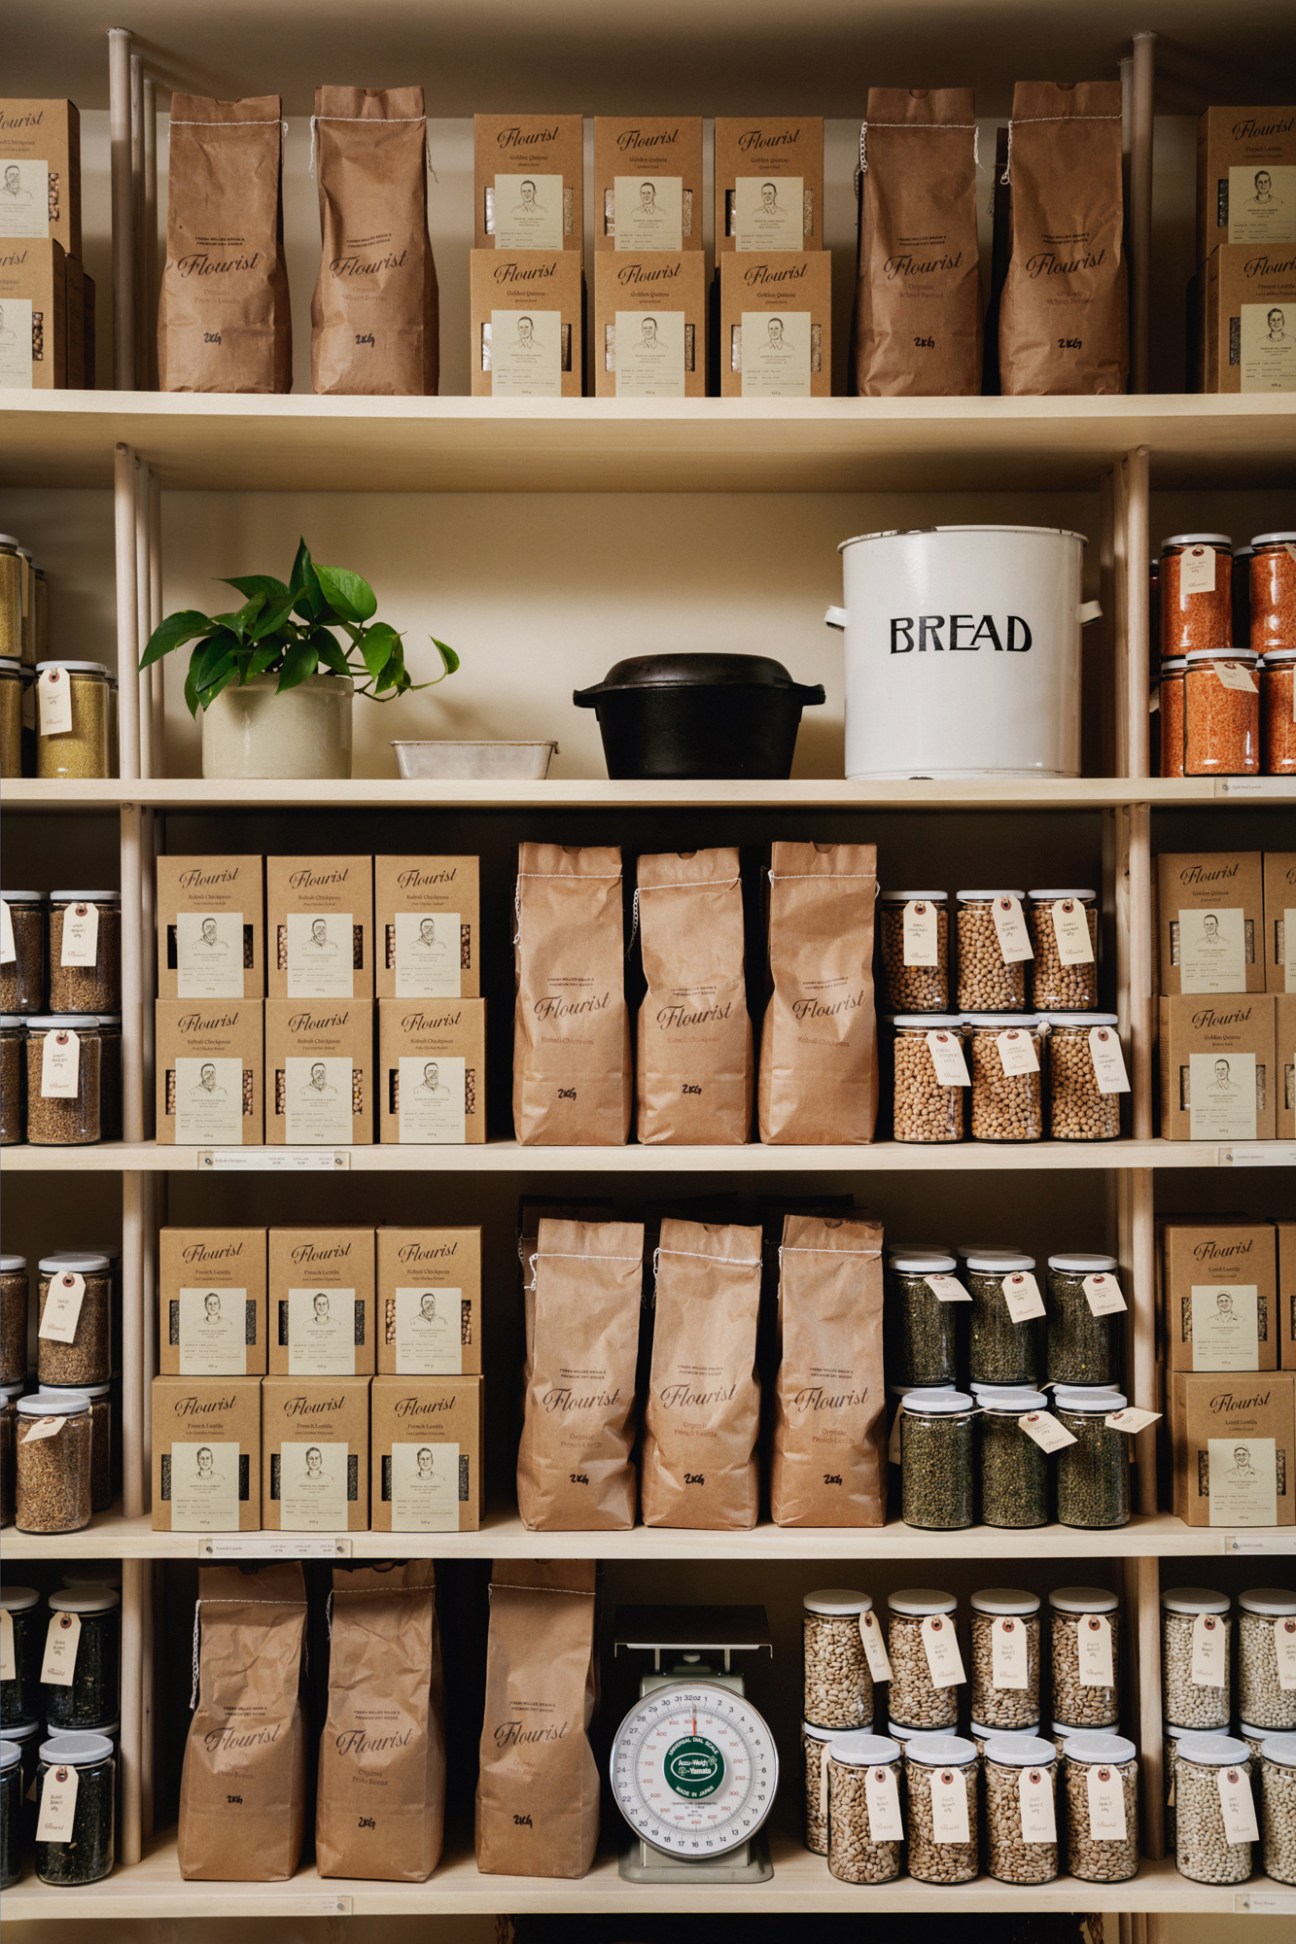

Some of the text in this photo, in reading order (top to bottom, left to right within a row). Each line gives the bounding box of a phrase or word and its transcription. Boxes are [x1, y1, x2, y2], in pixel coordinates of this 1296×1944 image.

[497, 126, 560, 149] Flourist
[616, 128, 679, 151] Flourist
[738, 128, 800, 152] Flourist
[177, 252, 259, 278] Flourist
[329, 249, 408, 278] Flourist
[493, 262, 557, 285] Flourist
[617, 263, 681, 286] Flourist
[744, 263, 808, 287] Flourist
[883, 252, 962, 280] Flourist
[1026, 249, 1106, 279] Flourist
[890, 614, 1033, 655] BREAD
[179, 867, 240, 889] Flourist
[289, 867, 349, 889] Flourist
[397, 867, 457, 889] Flourist
[1179, 864, 1241, 887] Flourist
[533, 991, 611, 1022] Flourist
[656, 1001, 734, 1030] Flourist
[791, 990, 865, 1021] Flourist
[178, 1011, 240, 1033] Flourist
[288, 1011, 349, 1033] Flourist
[401, 1011, 461, 1033] Flourist
[1191, 1007, 1252, 1031] Flourist
[182, 1241, 244, 1264] Flourist
[291, 1242, 351, 1264] Flourist
[398, 1242, 458, 1264] Flourist
[1193, 1239, 1254, 1263] Flourist
[174, 1395, 236, 1417] Flourist
[283, 1395, 345, 1418] Flourist
[394, 1395, 456, 1418] Flourist
[542, 1387, 620, 1414] Flourist
[660, 1383, 737, 1410] Flourist
[794, 1385, 870, 1413] Flourist
[1209, 1391, 1271, 1416] Flourist
[203, 1723, 282, 1757] Flourist
[335, 1726, 412, 1757] Flourist
[494, 1721, 567, 1749] Flourist
